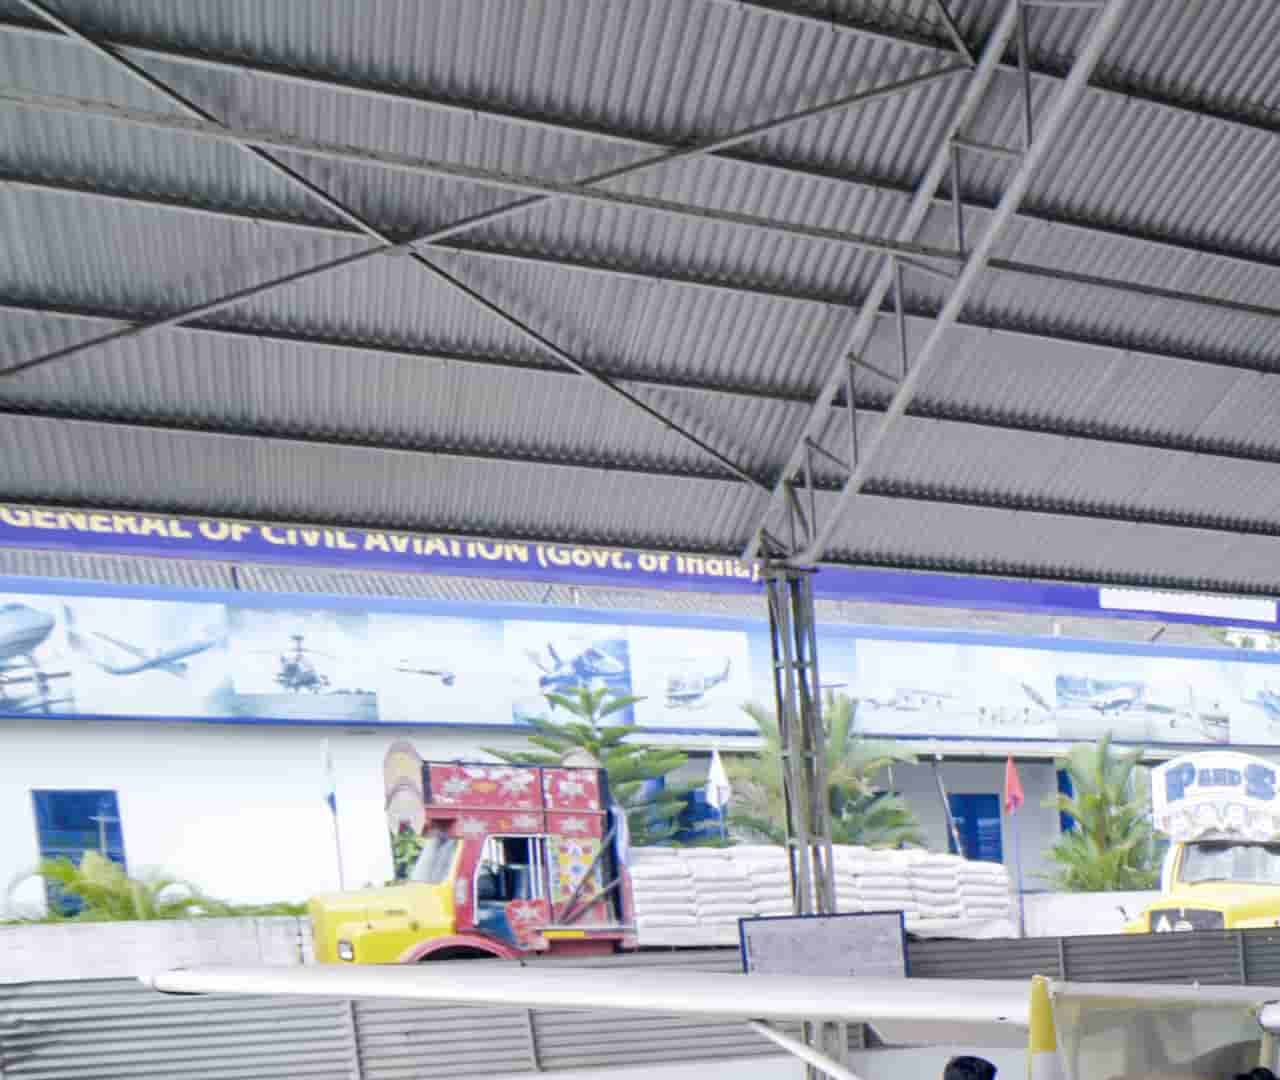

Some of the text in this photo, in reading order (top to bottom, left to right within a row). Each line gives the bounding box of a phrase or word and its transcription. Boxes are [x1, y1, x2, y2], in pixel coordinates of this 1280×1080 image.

[2, 509, 192, 538] GENERAL
[199, 517, 251, 541] OF
[261, 526, 357, 550] CIVIL
[364, 533, 528, 563] AVIATION
